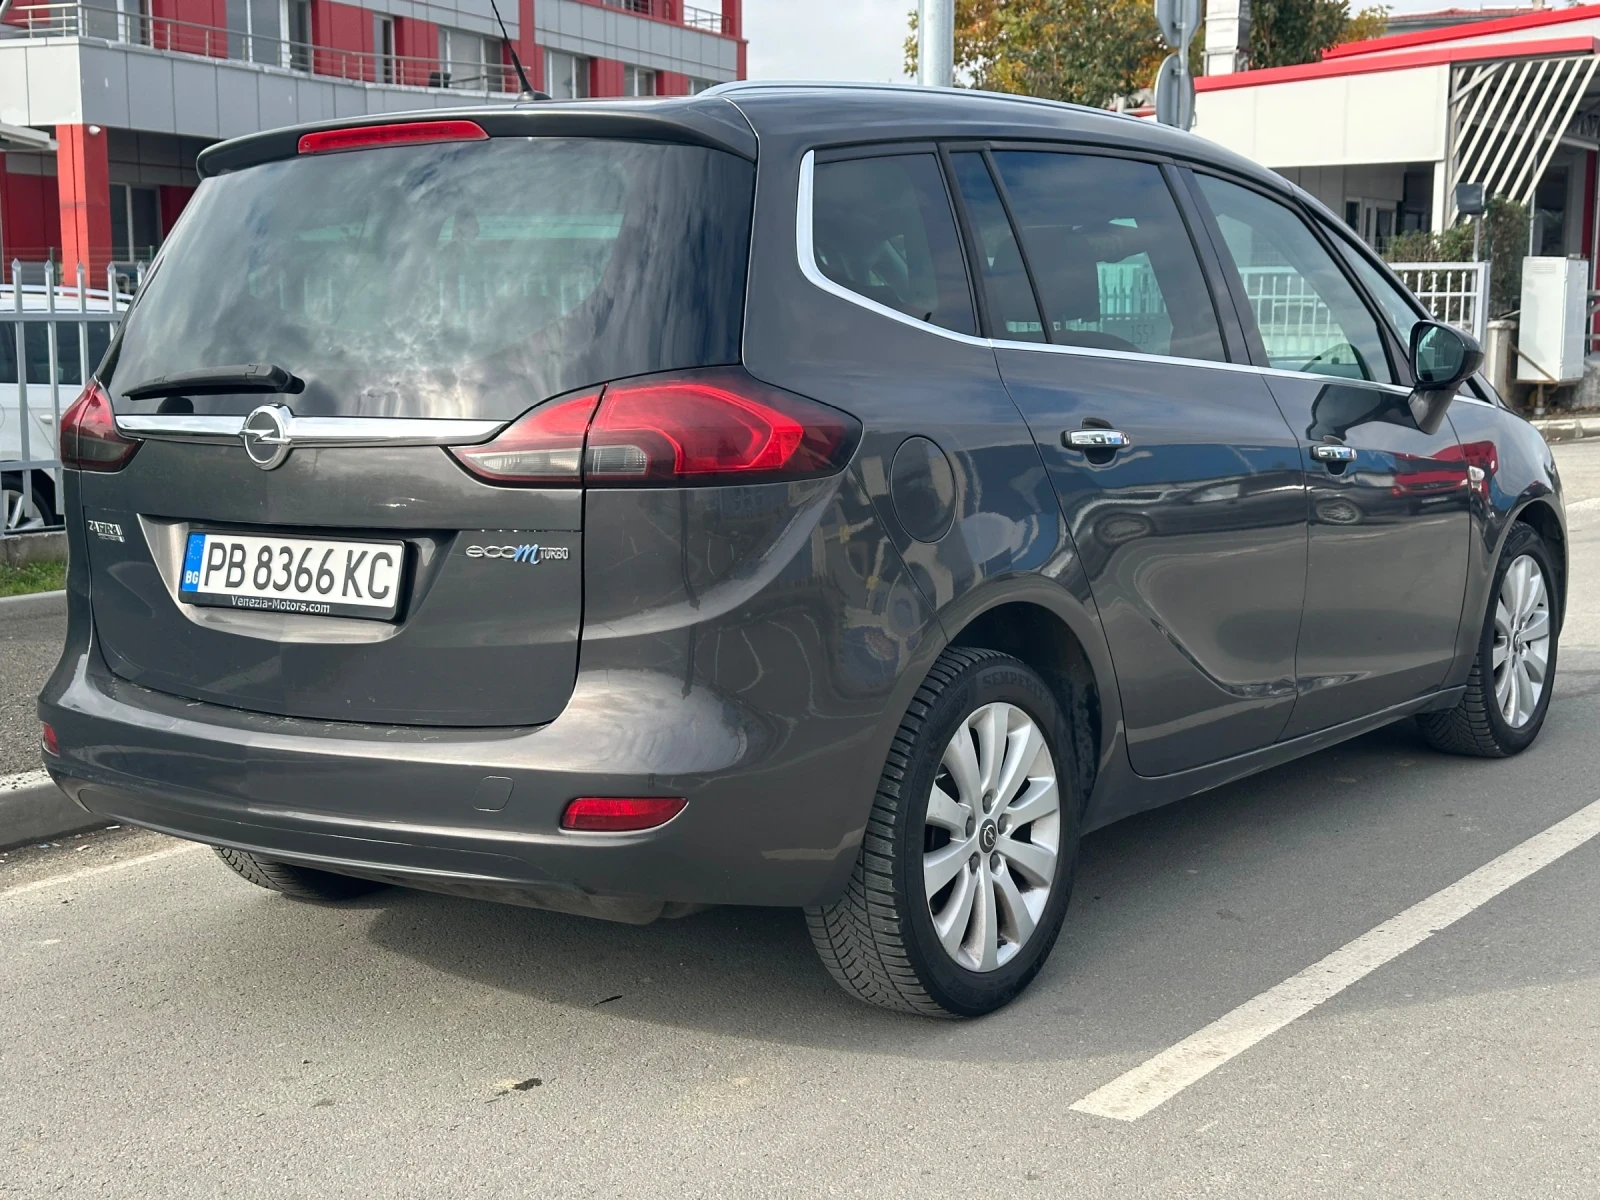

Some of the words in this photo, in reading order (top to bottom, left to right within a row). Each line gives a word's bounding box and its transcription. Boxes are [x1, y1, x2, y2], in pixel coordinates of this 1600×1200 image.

[539, 547, 569, 559] TURBO
[185, 571, 199, 584] BG
[204, 542, 247, 588] PB
[253, 545, 335, 595] 8366
[341, 549, 393, 599] KC
[231, 595, 331, 614] Venezia-Motors.com
[982, 670, 1044, 702] SEMPERIT
